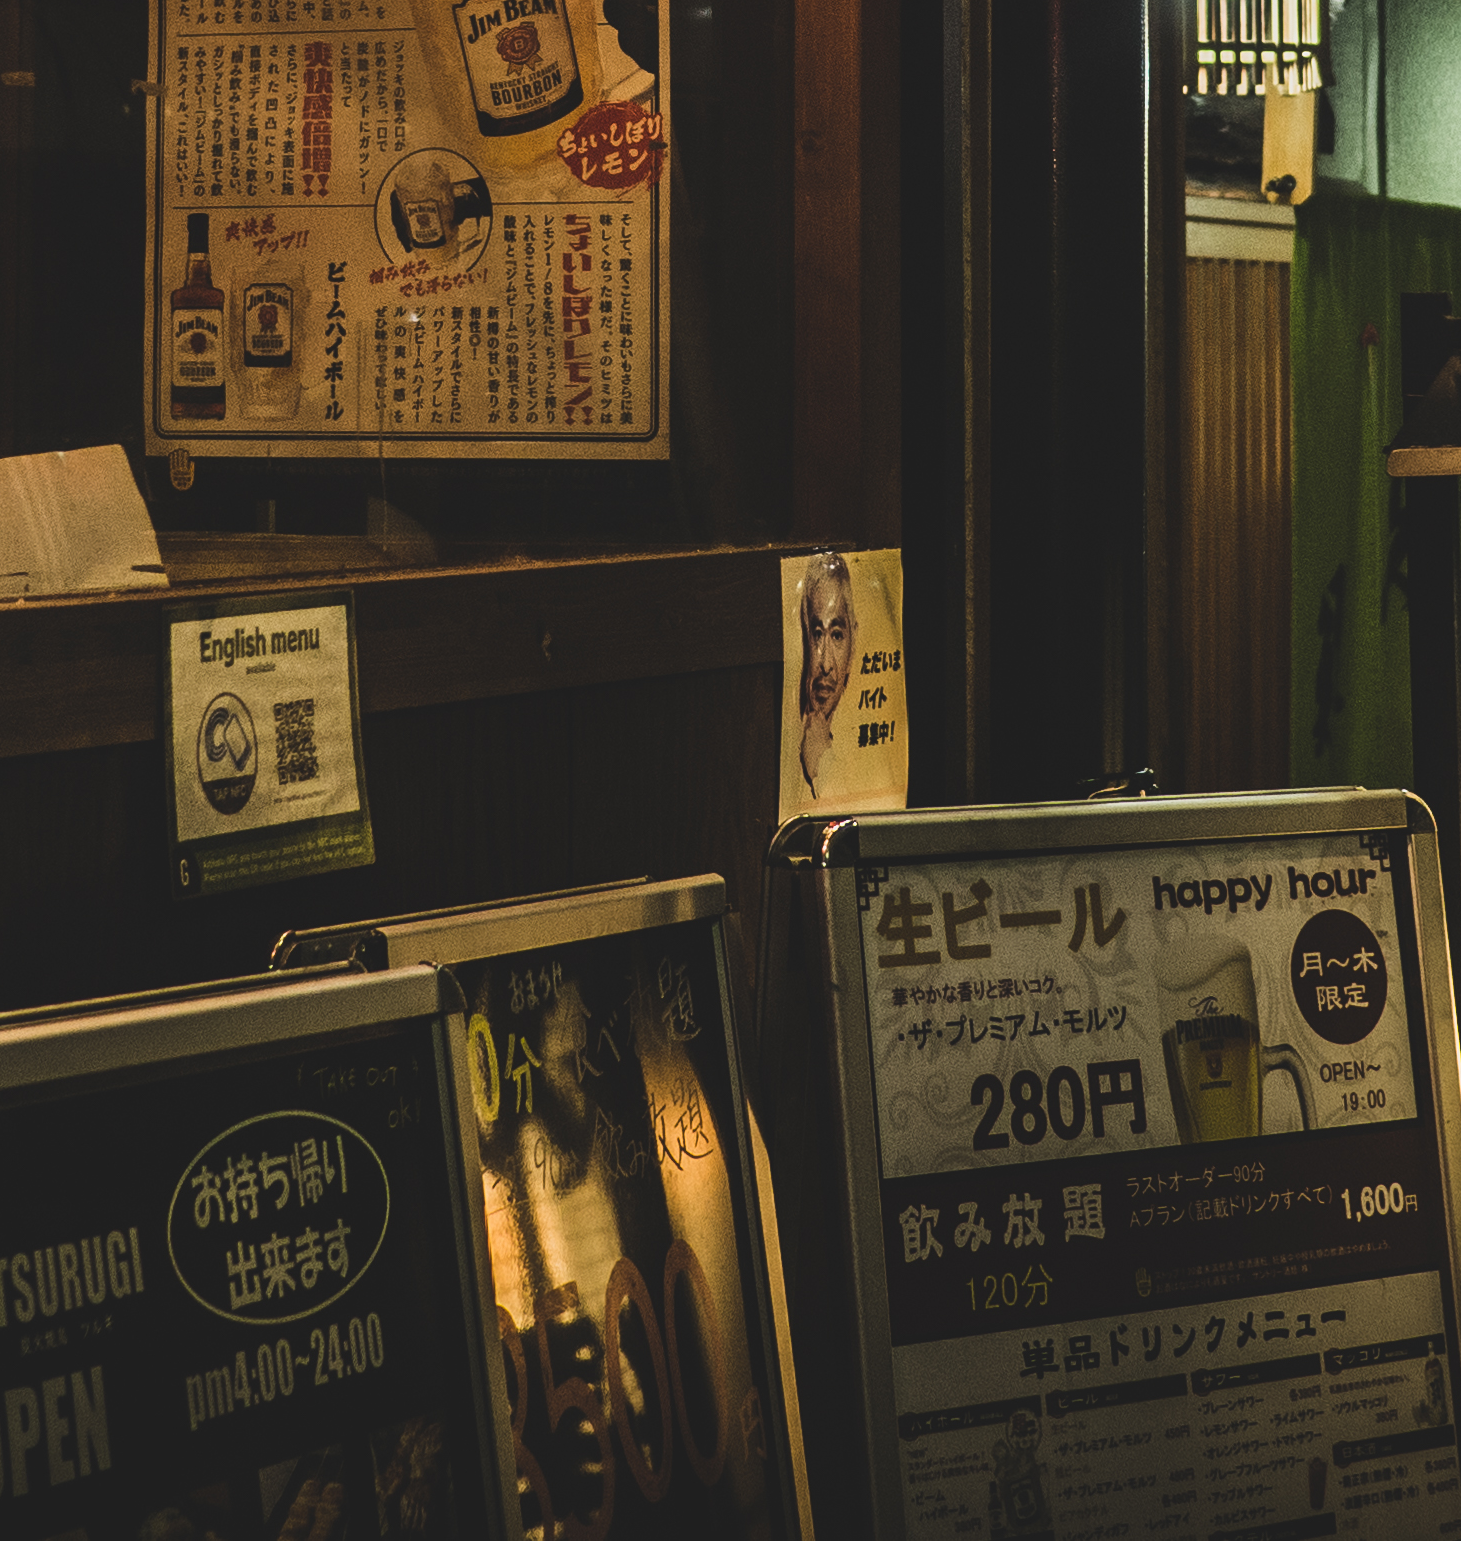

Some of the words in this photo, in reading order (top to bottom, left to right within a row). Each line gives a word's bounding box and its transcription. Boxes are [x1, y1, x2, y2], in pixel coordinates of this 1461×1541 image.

[467, 9, 502, 44] JIM
[491, 69, 563, 107] BOURBON
[558, 114, 663, 159] ちょいしぼり
[580, 148, 648, 181] レモン
[325, 261, 347, 422] ビームハイボール
[199, 627, 267, 668] English
[271, 627, 320, 654] menu
[859, 649, 901, 675] ただいま
[858, 686, 887, 710] バイト
[857, 720, 896, 748] 募集中!
[1152, 872, 1273, 916] happy
[1288, 866, 1377, 899] hour
[875, 877, 1127, 970] 生ビール
[891, 979, 1065, 1008] 華やかな香りと深いコク。
[1316, 983, 1370, 1012] 限定
[1175, 1013, 1244, 1045] PREMIUM
[969, 1058, 1148, 1151] 280円
[1340, 1087, 1387, 1113] 19:00
[192, 1136, 350, 1229] お持ち帰り
[1125, 1161, 1267, 1198] ラストオーダー90分
[1340, 1181, 1419, 1224] 1,600円
[899, 1183, 1106, 1263] 飲み放題
[225, 1218, 353, 1310] 出来ます
[966, 1264, 1054, 1311] 120分
[1019, 1308, 1348, 1380] 単品ドリンクメニュー
[1331, 1346, 1383, 1367] マッコリ
[1055, 1393, 1100, 1410] ビール
